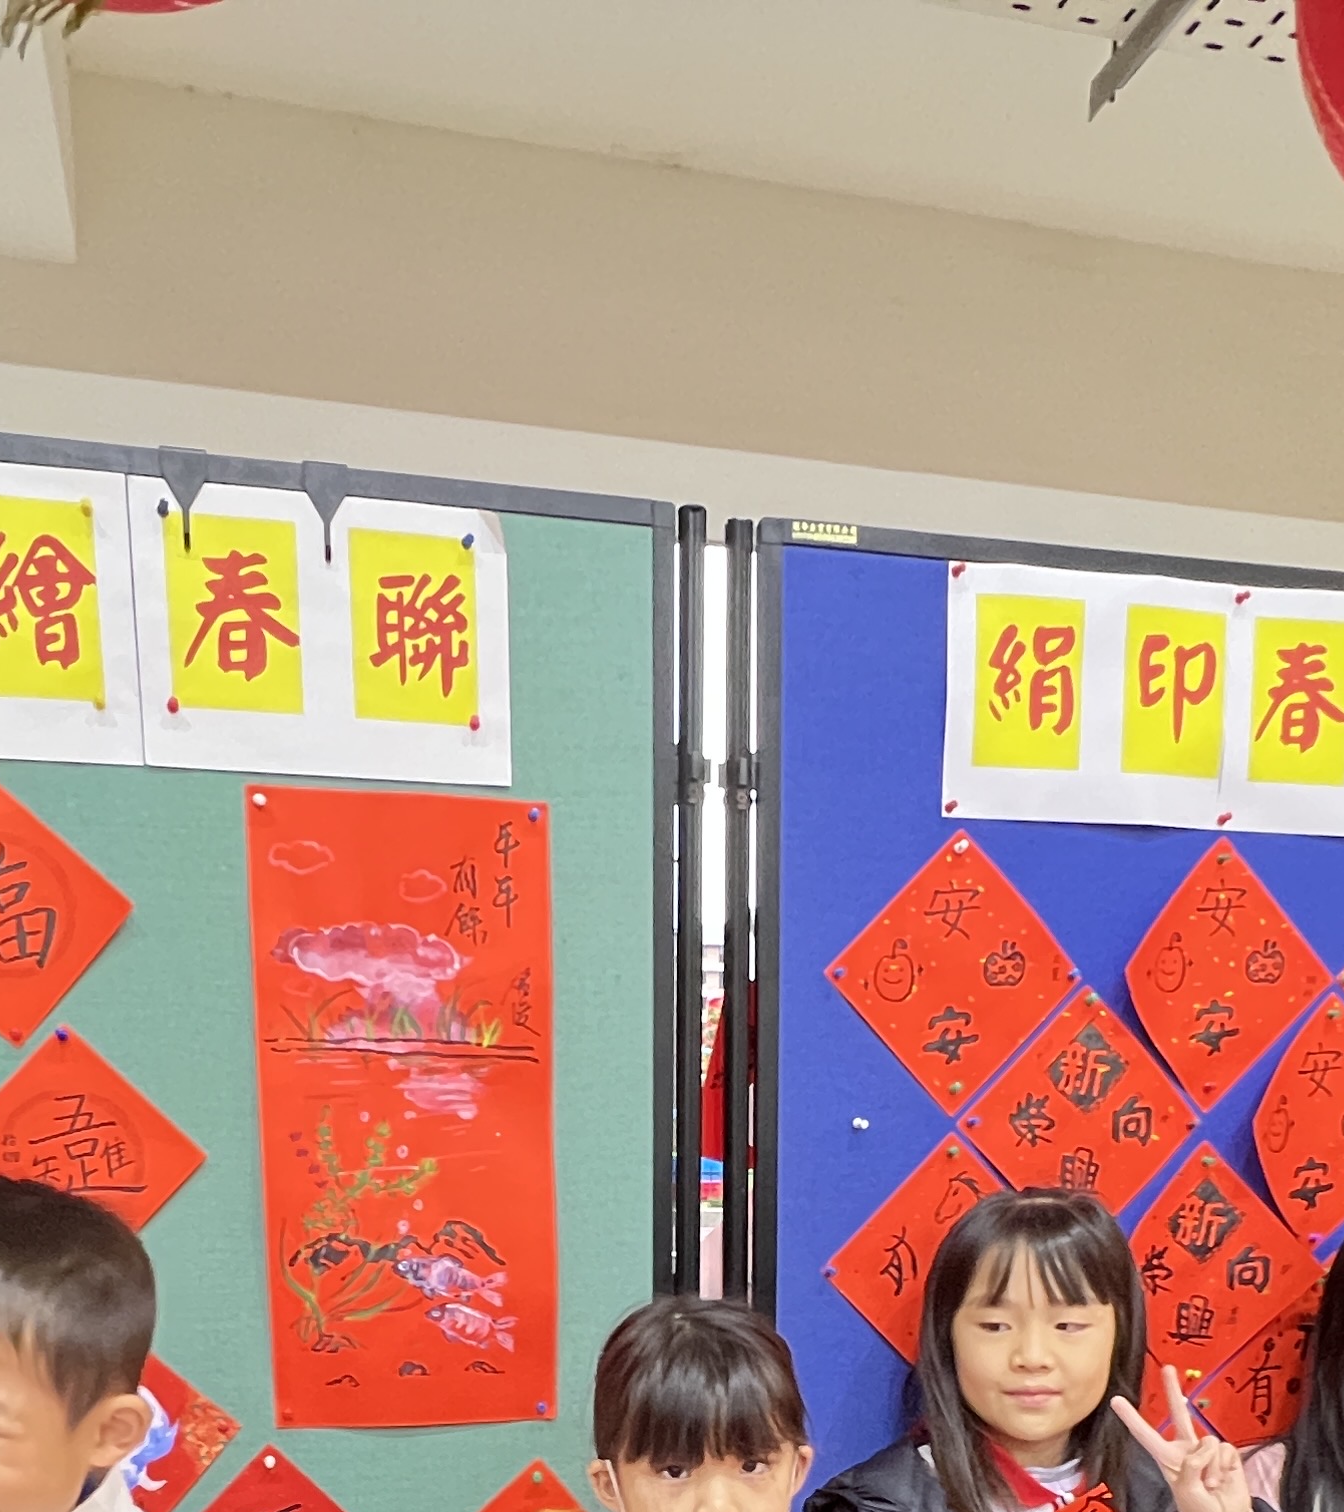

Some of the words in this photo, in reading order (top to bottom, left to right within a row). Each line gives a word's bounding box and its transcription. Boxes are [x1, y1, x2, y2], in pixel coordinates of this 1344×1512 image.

[924, 881, 982, 940] 安
[1196, 878, 1248, 937] 安
[923, 1006, 980, 1065] 安
[1189, 1000, 1240, 1057] 安
[1297, 1042, 1343, 1097] 安
[1289, 1156, 1334, 1211] 安
